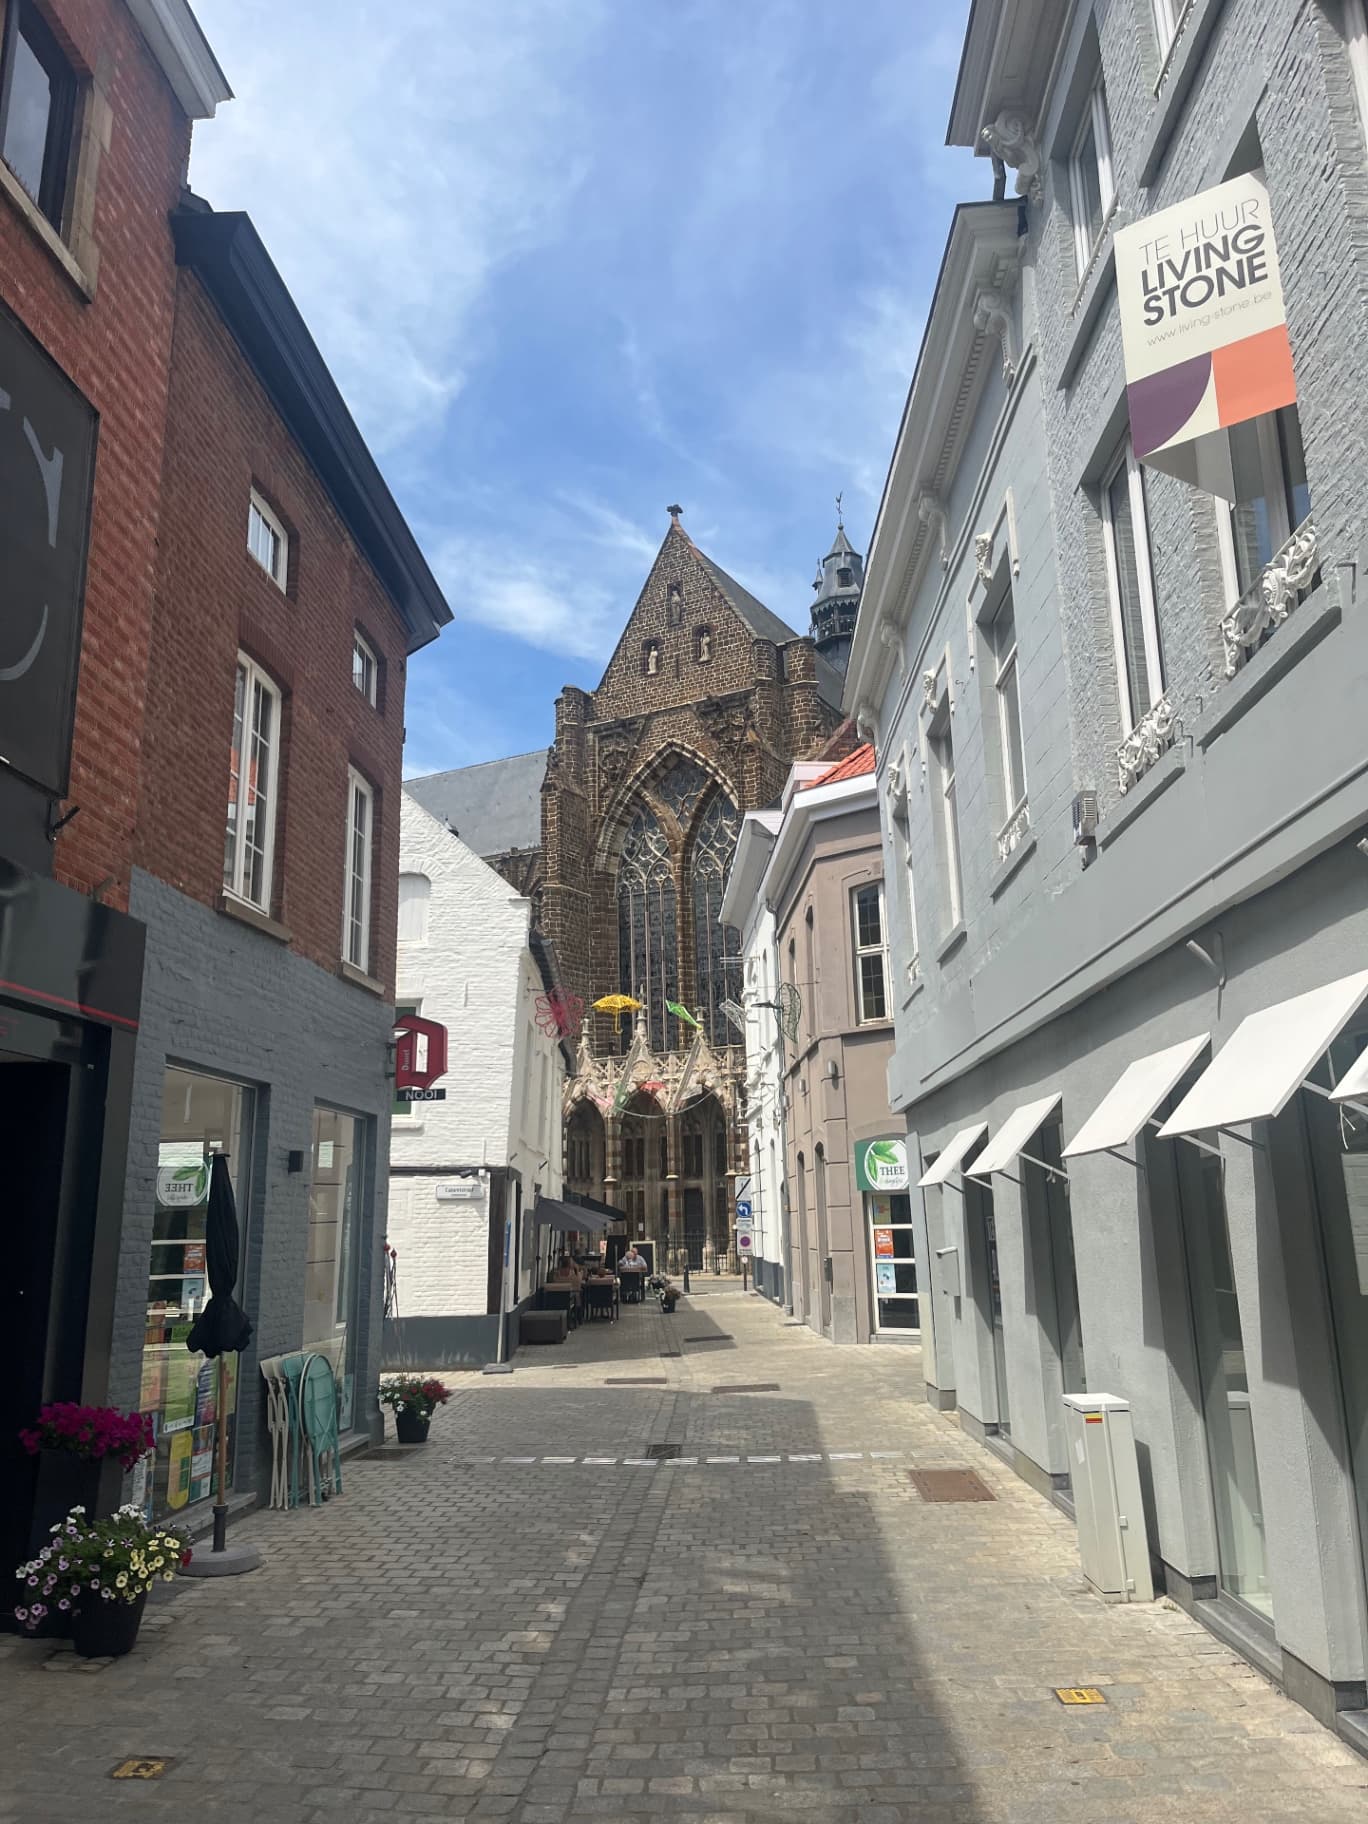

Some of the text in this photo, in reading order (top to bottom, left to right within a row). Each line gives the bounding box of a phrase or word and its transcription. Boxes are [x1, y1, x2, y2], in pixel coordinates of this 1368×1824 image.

[1138, 199, 1259, 265] TE HUUR
[1141, 224, 1265, 297] LIVING
[1143, 250, 1268, 326] STONE
[1147, 291, 1272, 346] www.living-stone.be
[405, 1089, 437, 1100] NOOI
[879, 1166, 905, 1176] THEE
